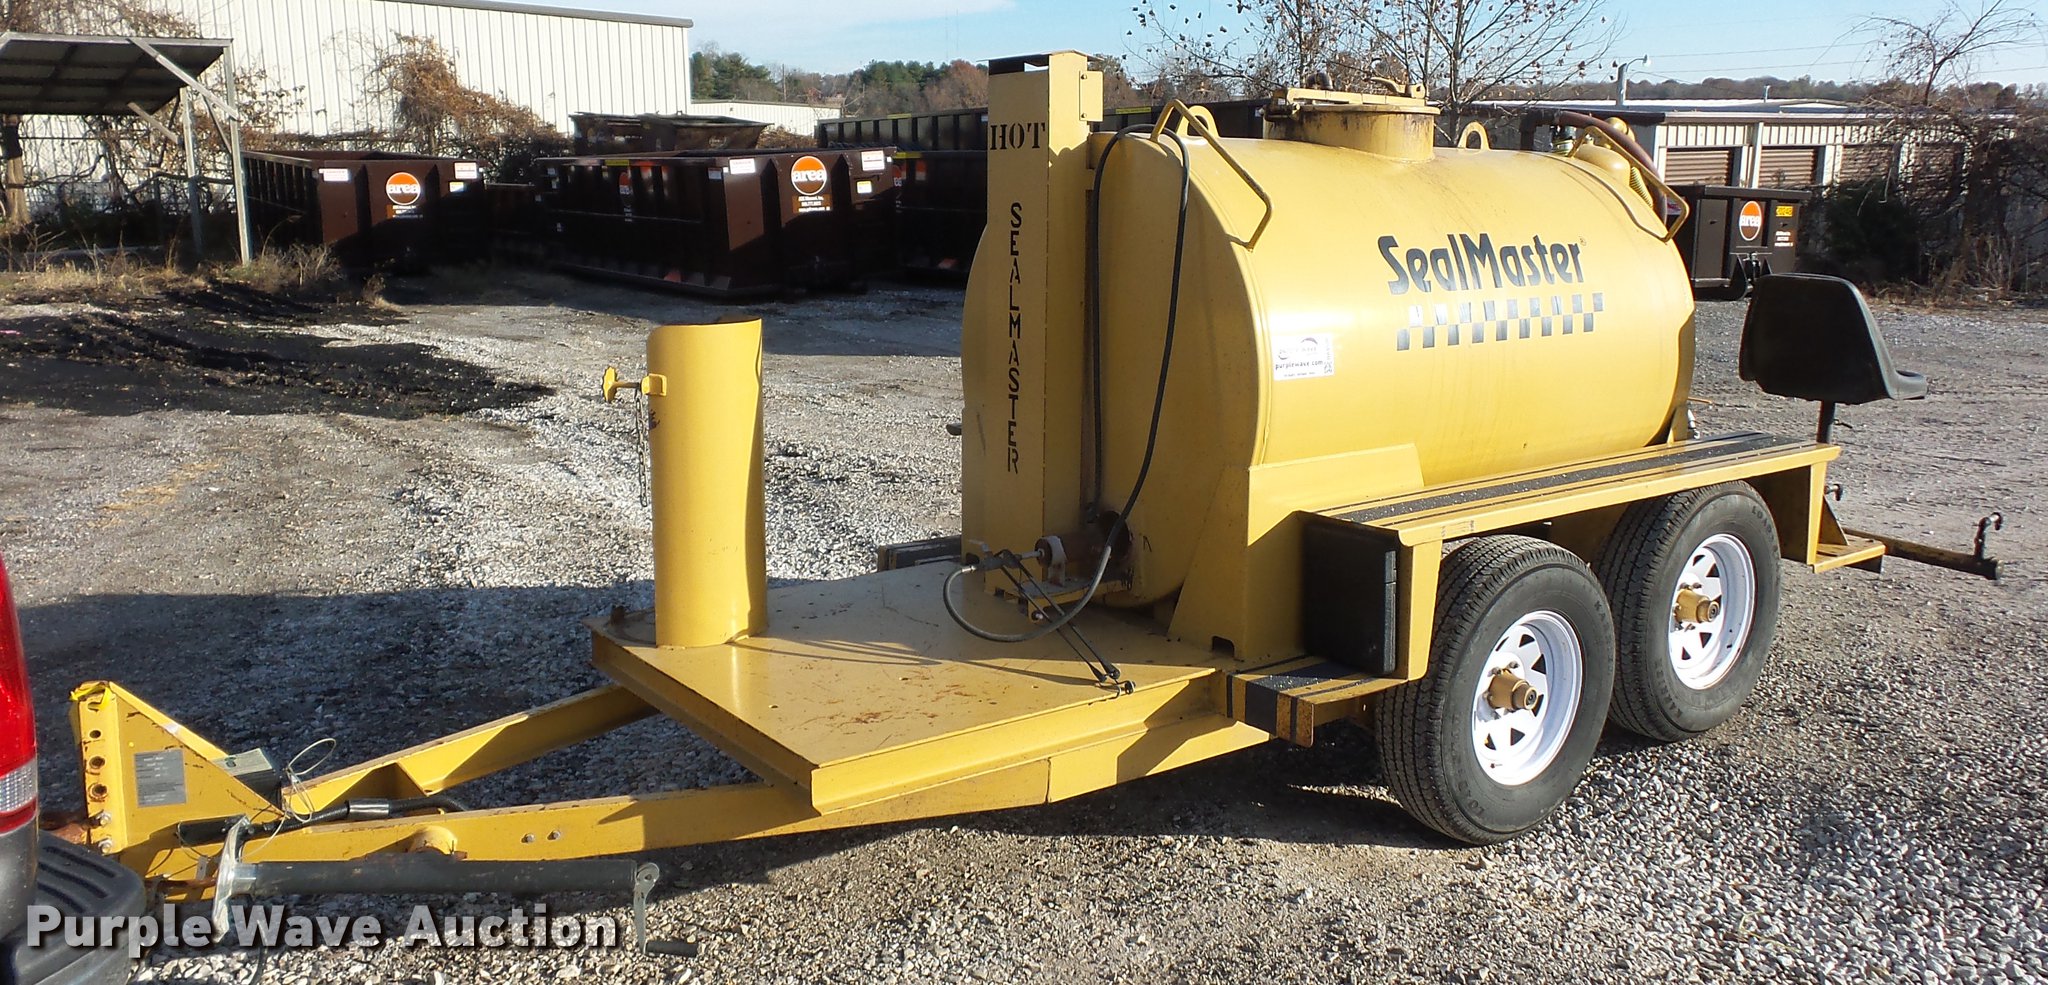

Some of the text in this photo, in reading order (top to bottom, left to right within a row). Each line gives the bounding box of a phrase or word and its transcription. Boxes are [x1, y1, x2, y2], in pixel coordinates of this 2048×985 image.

[990, 122, 1045, 150] HOT
[387, 184, 418, 194] area
[791, 170, 825, 182] area
[1377, 233, 1584, 295] SealMaster
[1007, 202, 1022, 474] SEALMASTER
